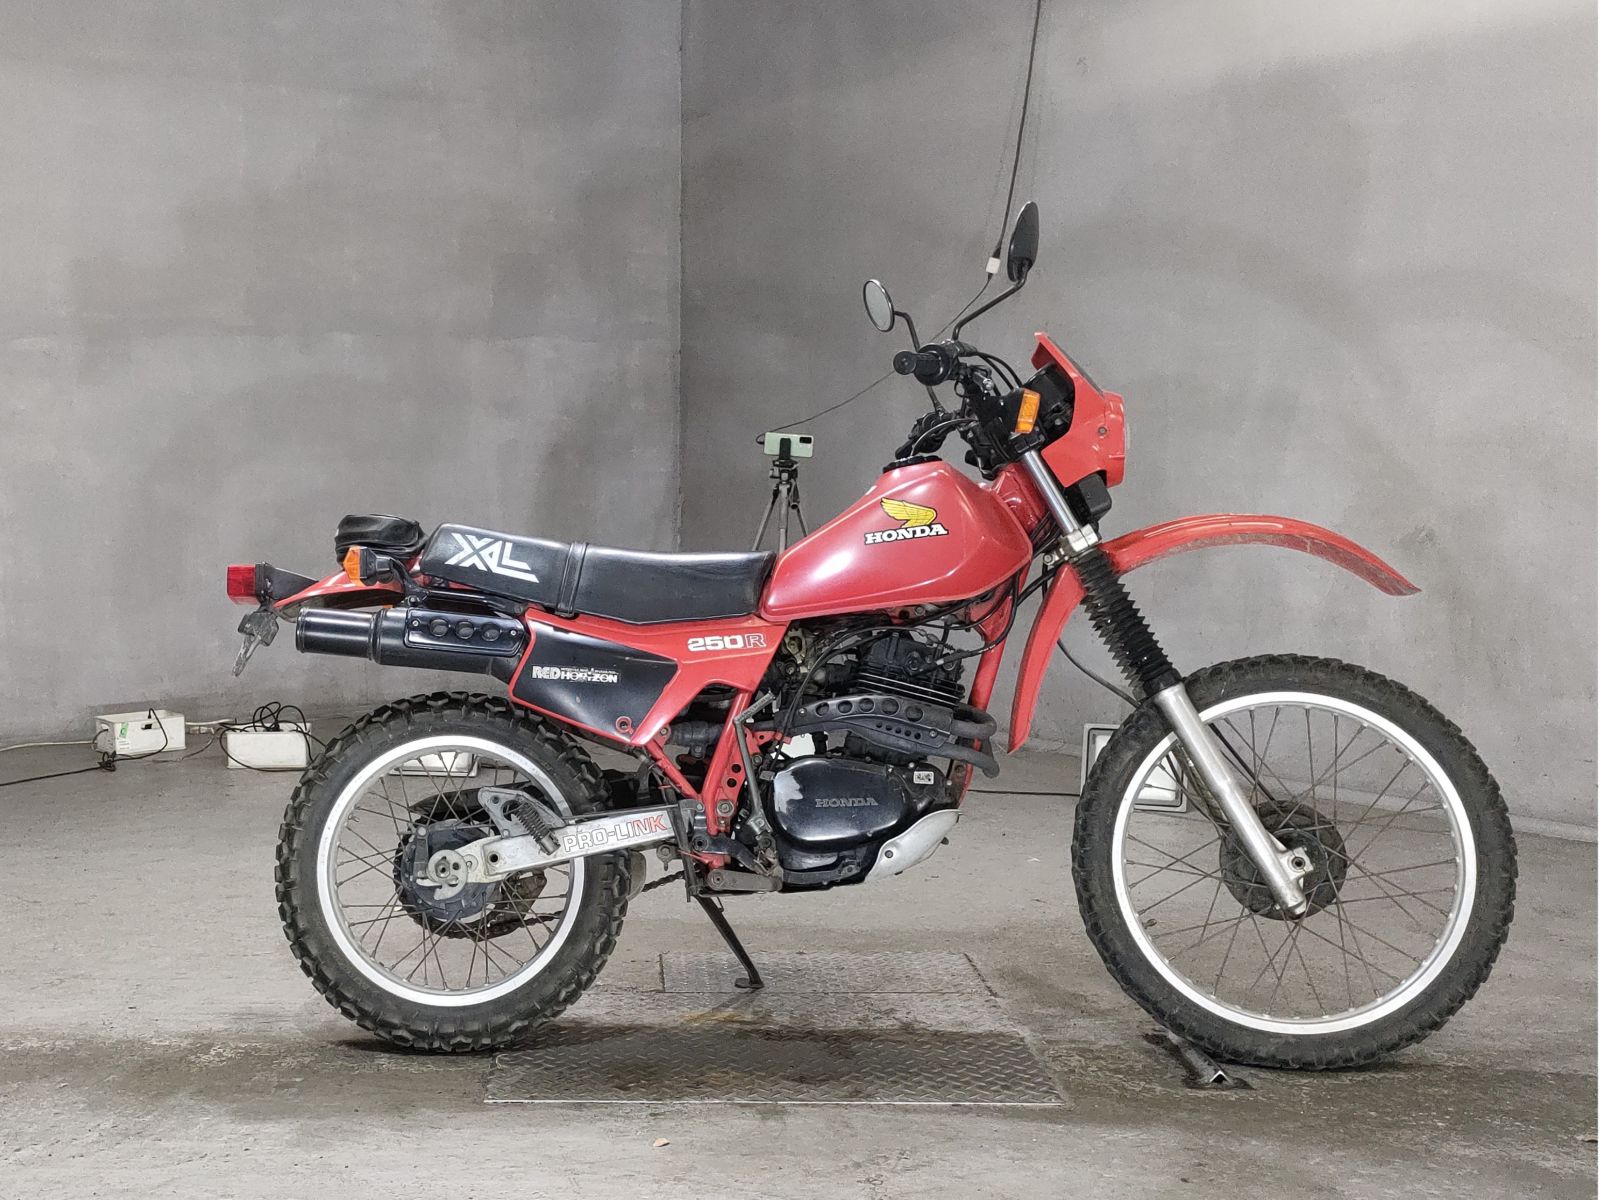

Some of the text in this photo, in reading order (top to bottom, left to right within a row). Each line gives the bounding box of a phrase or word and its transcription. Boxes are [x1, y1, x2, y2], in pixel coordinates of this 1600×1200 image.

[864, 523, 949, 545] HONDA
[444, 532, 540, 584] XL
[532, 665, 618, 683] RED HORIZON
[815, 797, 879, 808] HONDA
[563, 814, 668, 853] PRO-LINK
